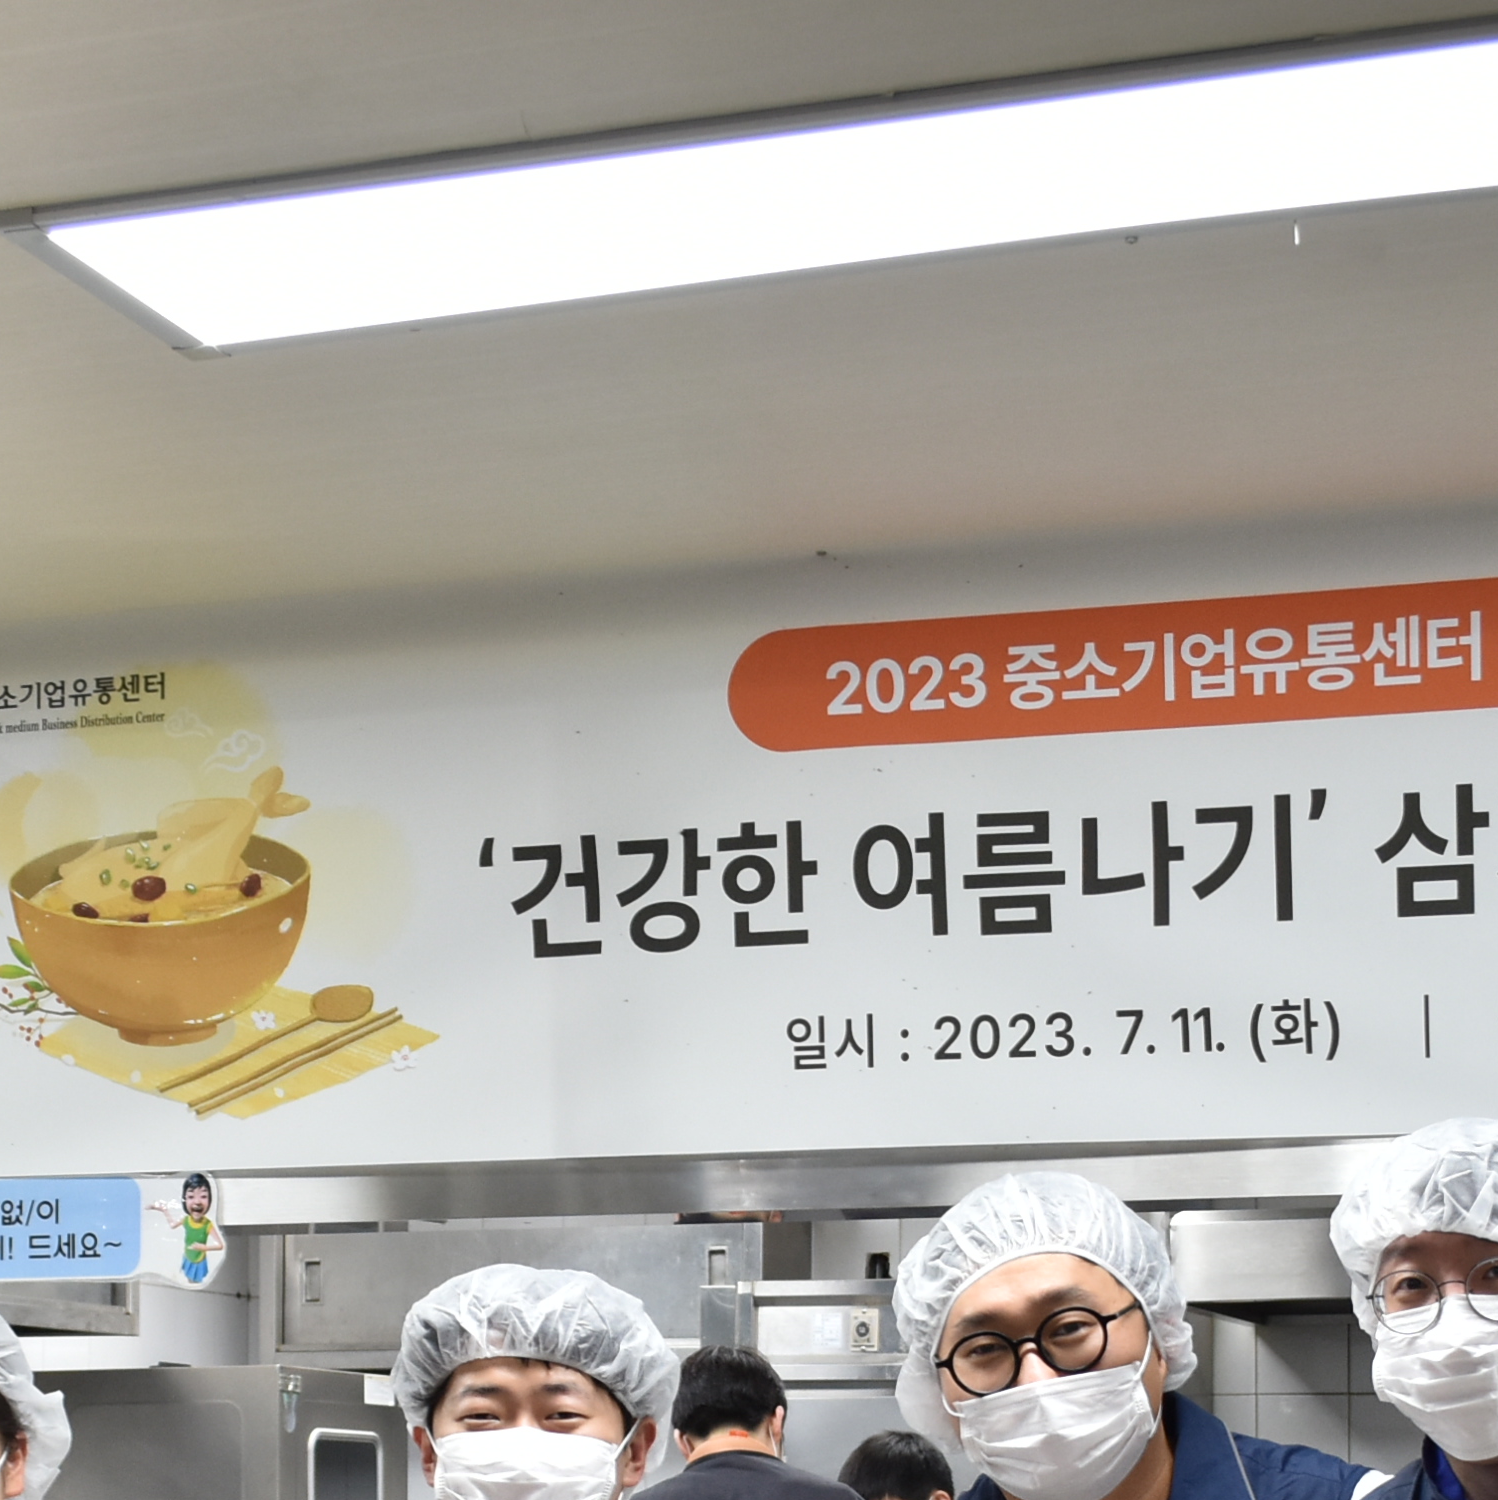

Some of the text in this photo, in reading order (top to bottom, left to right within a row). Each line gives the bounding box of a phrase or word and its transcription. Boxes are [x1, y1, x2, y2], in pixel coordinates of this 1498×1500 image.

[826, 652, 988, 716] 2023
[1002, 610, 1483, 711] 중소기업유통센터
[5, 719, 40, 734] medium
[41, 717, 78, 731] Business
[80, 712, 134, 728] Distribution
[135, 710, 166, 724] Center
[786, 1012, 875, 1071] 일시
[933, 1011, 1092, 1061] 2023.
[1249, 998, 1341, 1064] (화)
[28, 1232, 122, 1260] 드세요~
